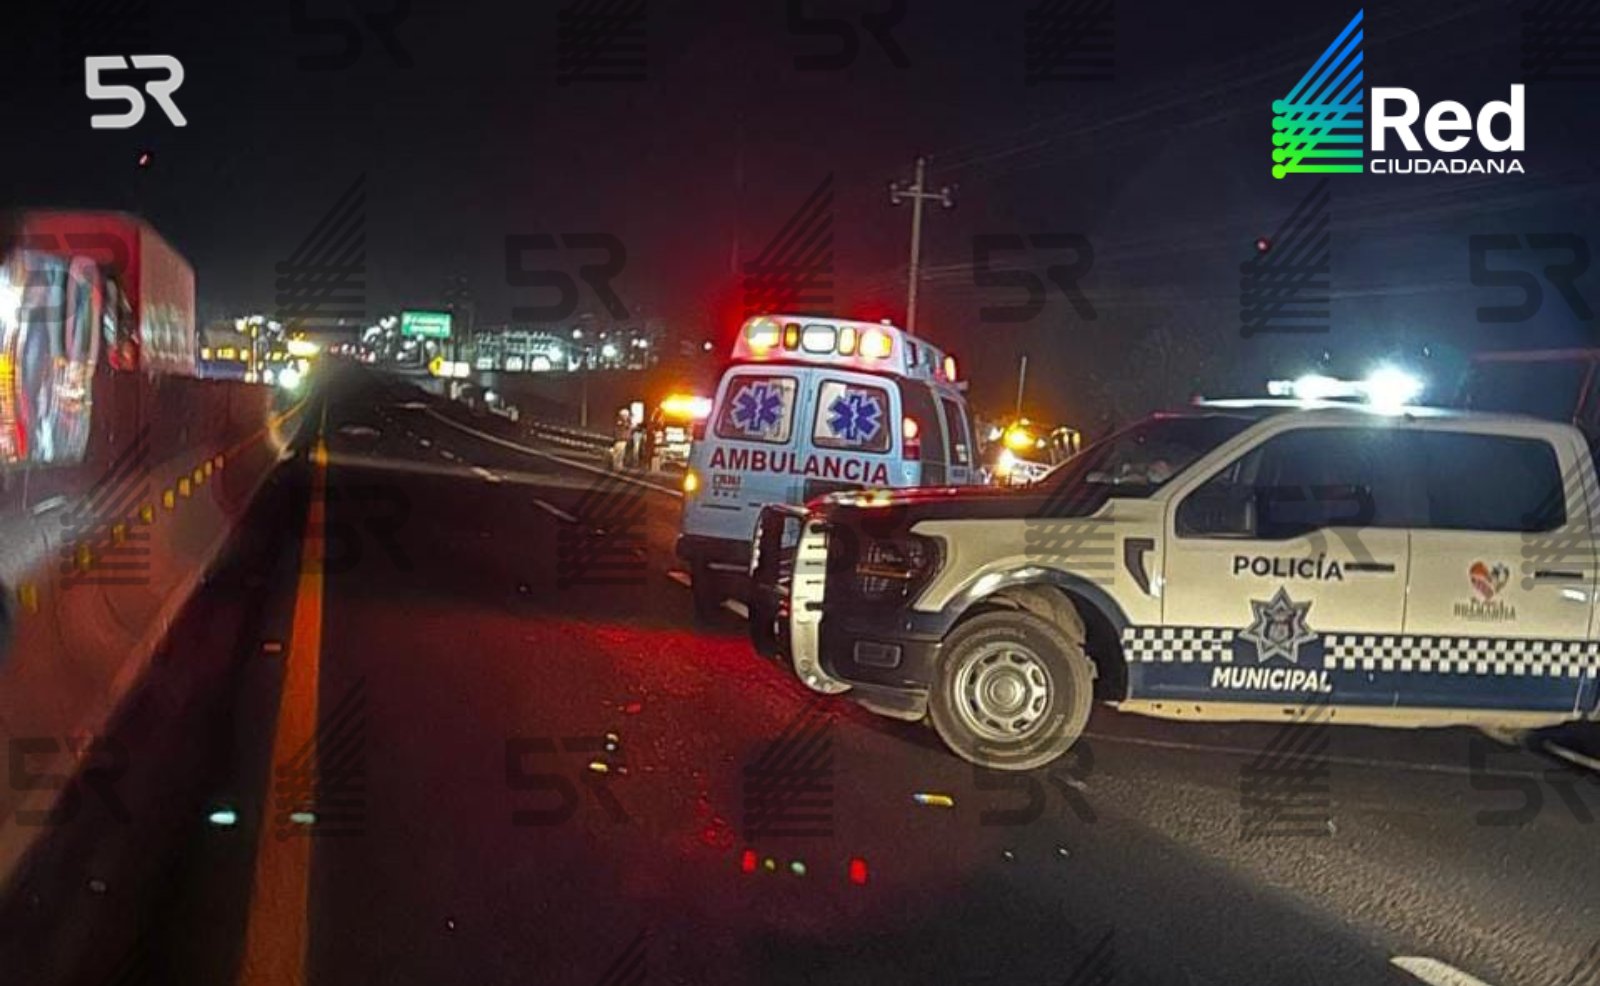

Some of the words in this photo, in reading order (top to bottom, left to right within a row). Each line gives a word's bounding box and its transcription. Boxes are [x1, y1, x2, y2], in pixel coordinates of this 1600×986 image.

[709, 446, 889, 485] AMBULANCIA
[1233, 552, 1344, 581] POLICÍA
[1211, 666, 1333, 694] MUNICIPAL
